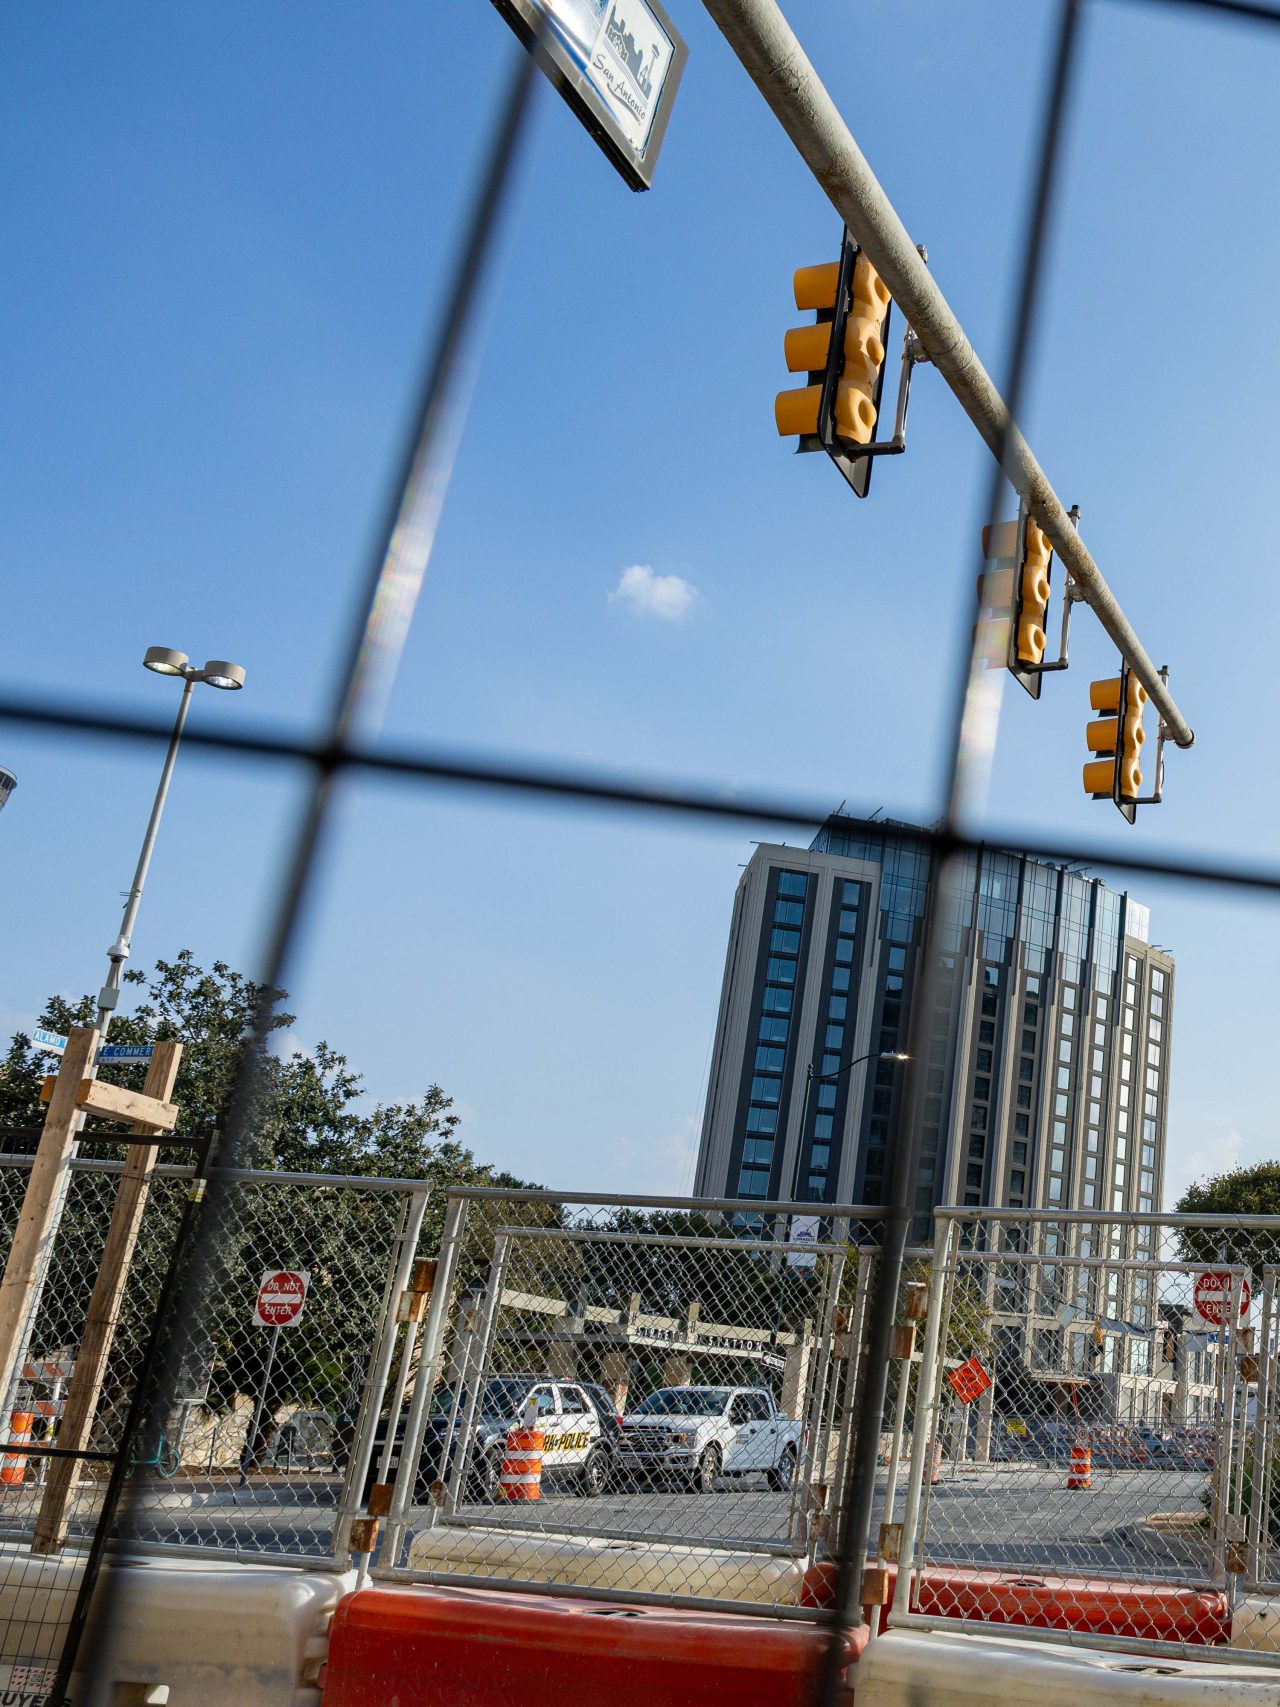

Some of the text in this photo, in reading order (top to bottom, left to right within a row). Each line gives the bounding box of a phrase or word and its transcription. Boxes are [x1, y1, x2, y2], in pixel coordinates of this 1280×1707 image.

[593, 53, 646, 119] San Antonio
[34, 1031, 61, 1046] ALAMO
[103, 1047, 154, 1056] E COMMER
[267, 1282, 301, 1291] DO NOT
[1203, 1278, 1217, 1288] DO
[264, 1306, 292, 1315] ENTER
[557, 1431, 590, 1451] POLICE
